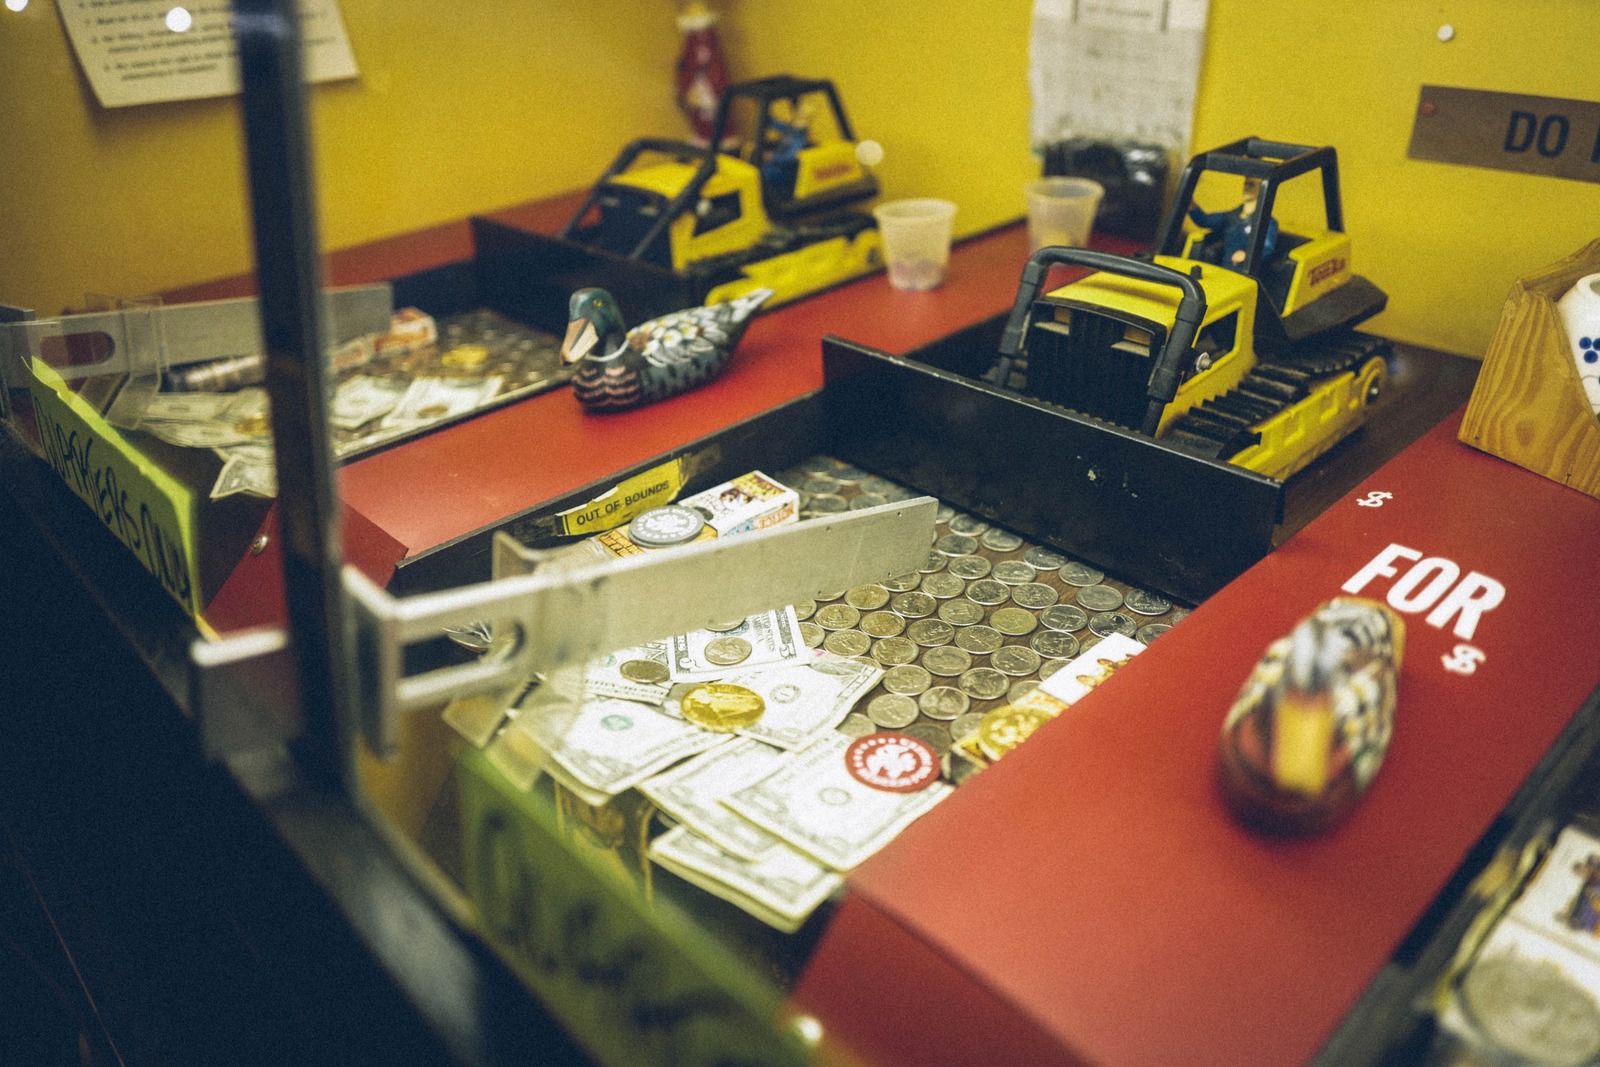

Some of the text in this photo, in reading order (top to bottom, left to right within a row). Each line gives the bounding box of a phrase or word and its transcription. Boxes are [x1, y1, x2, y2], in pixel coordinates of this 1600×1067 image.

[1504, 110, 1569, 159] DO
[576, 480, 670, 526] OUT OF BOUNDS
[1341, 542, 1507, 642] FOR
